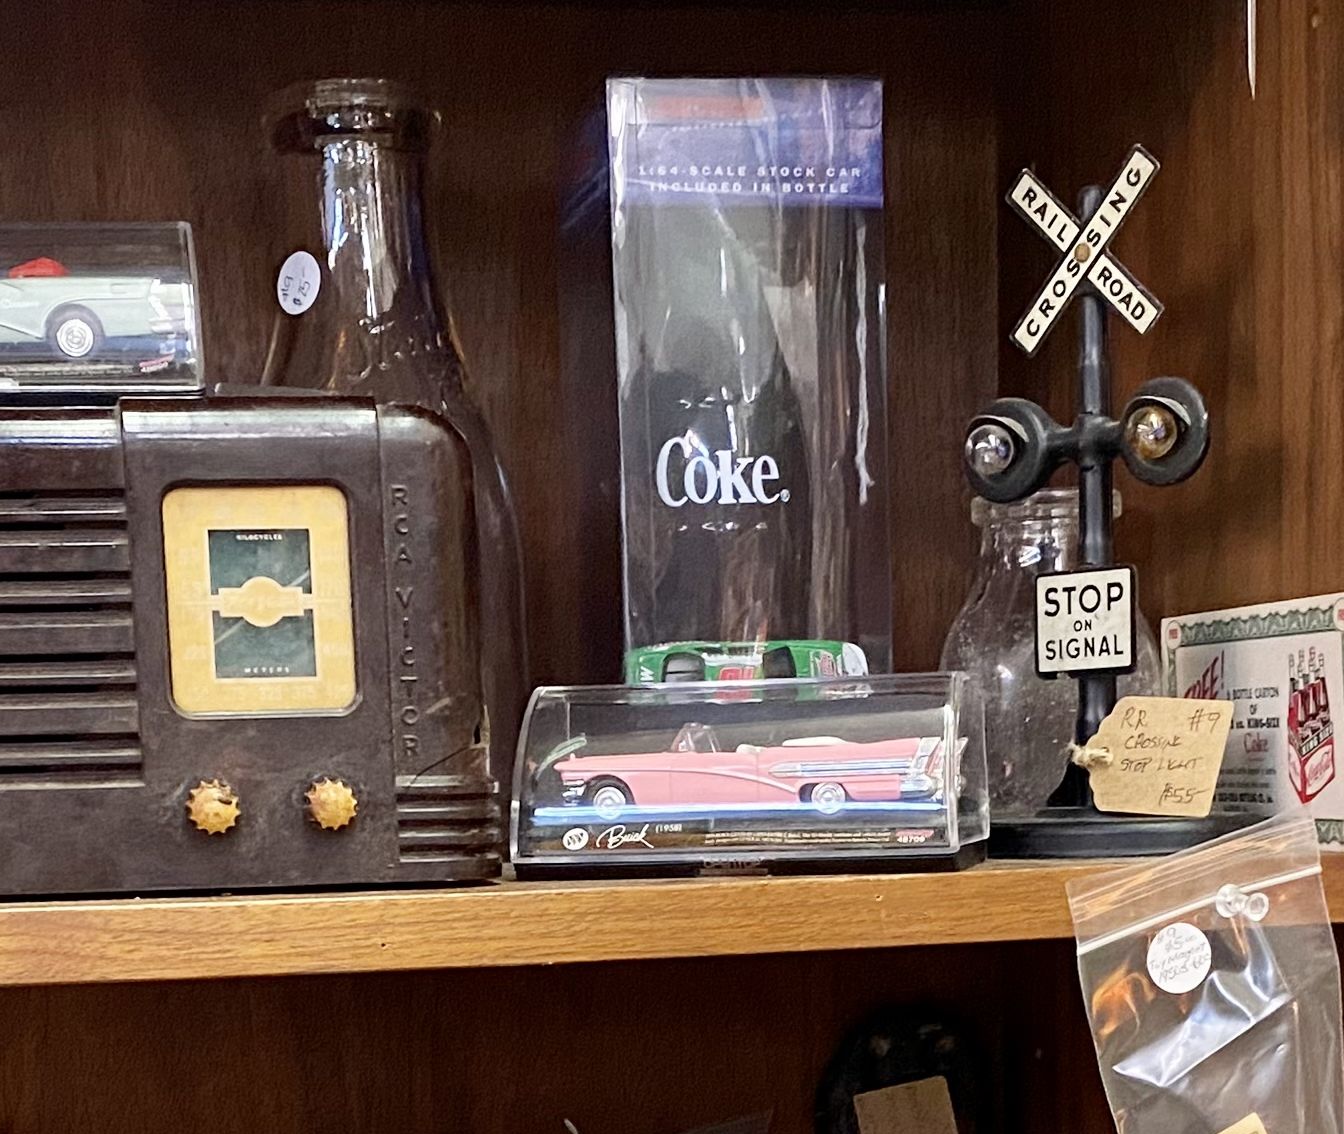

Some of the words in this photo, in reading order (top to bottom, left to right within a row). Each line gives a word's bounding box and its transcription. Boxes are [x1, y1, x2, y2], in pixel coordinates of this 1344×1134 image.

[757, 166, 816, 177] STOCK
[826, 166, 861, 178] CAR
[649, 183, 743, 193] INCLUDED
[753, 183, 771, 193] IN
[782, 183, 850, 194] BOTTLE
[1021, 185, 1068, 243] RAIL
[1097, 265, 1146, 321] ROAD
[1025, 167, 1142, 338] CROSSING
[656, 434, 782, 508] Coke
[390, 483, 413, 564] RCA
[1043, 581, 1125, 617] STOP
[1073, 619, 1093, 633] ON
[1044, 634, 1125, 661] SIGNAL
[395, 586, 420, 757] VICTOR
[1120, 706, 1148, 731] RR
[595, 823, 655, 849] Buick
